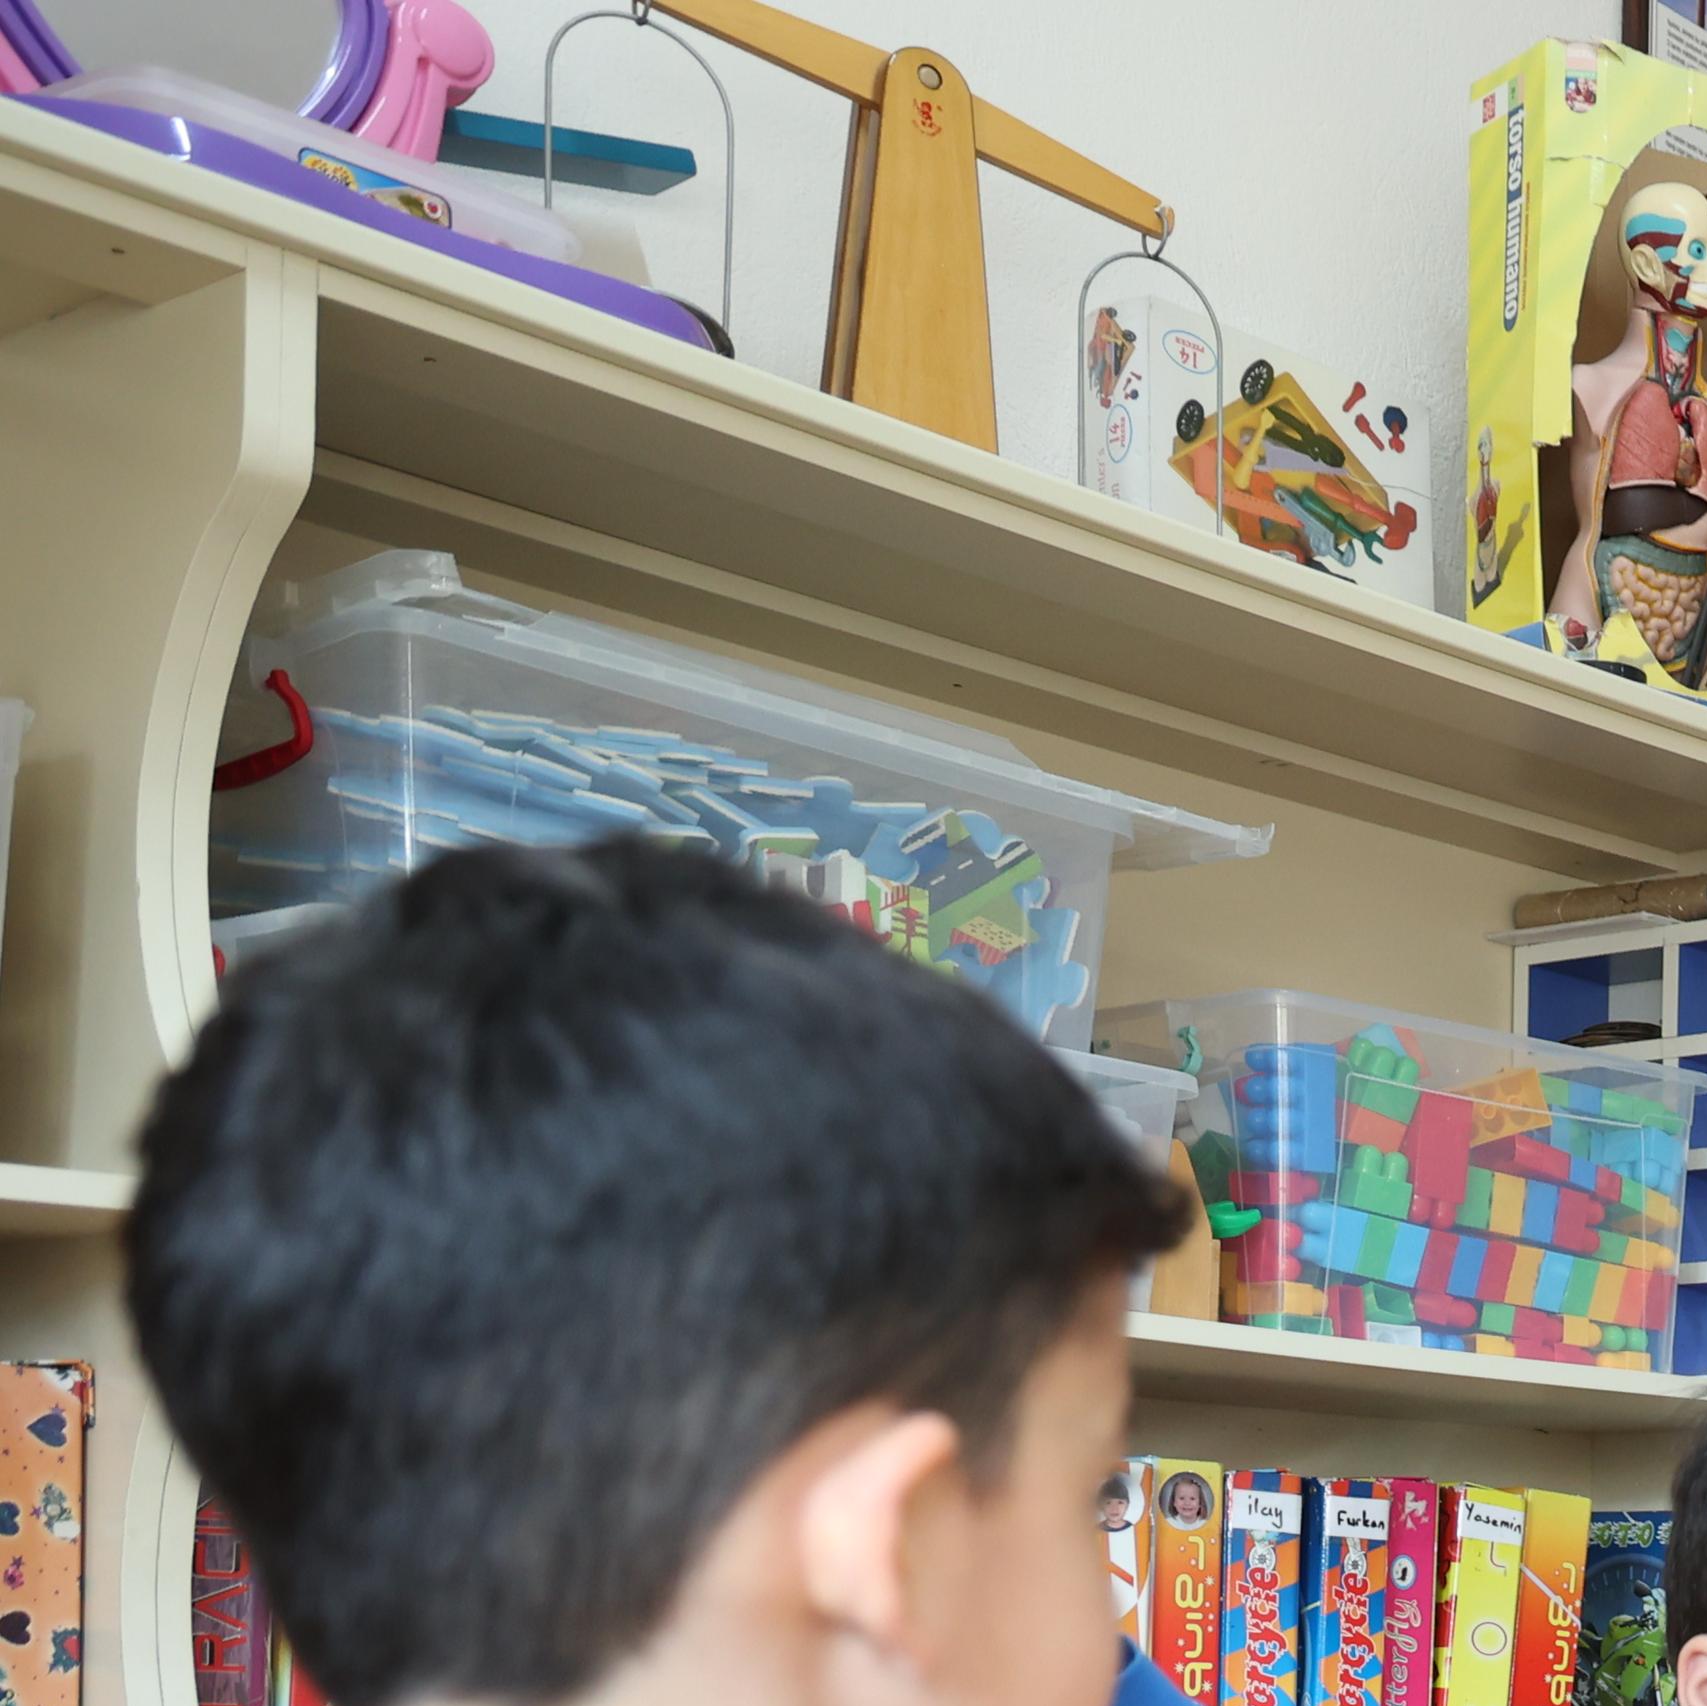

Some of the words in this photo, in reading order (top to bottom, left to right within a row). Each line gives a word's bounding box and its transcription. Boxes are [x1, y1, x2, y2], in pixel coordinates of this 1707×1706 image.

[1508, 107, 1524, 191] torso
[1504, 195, 1525, 321] humano
[1174, 1535, 1214, 1697] rainb
